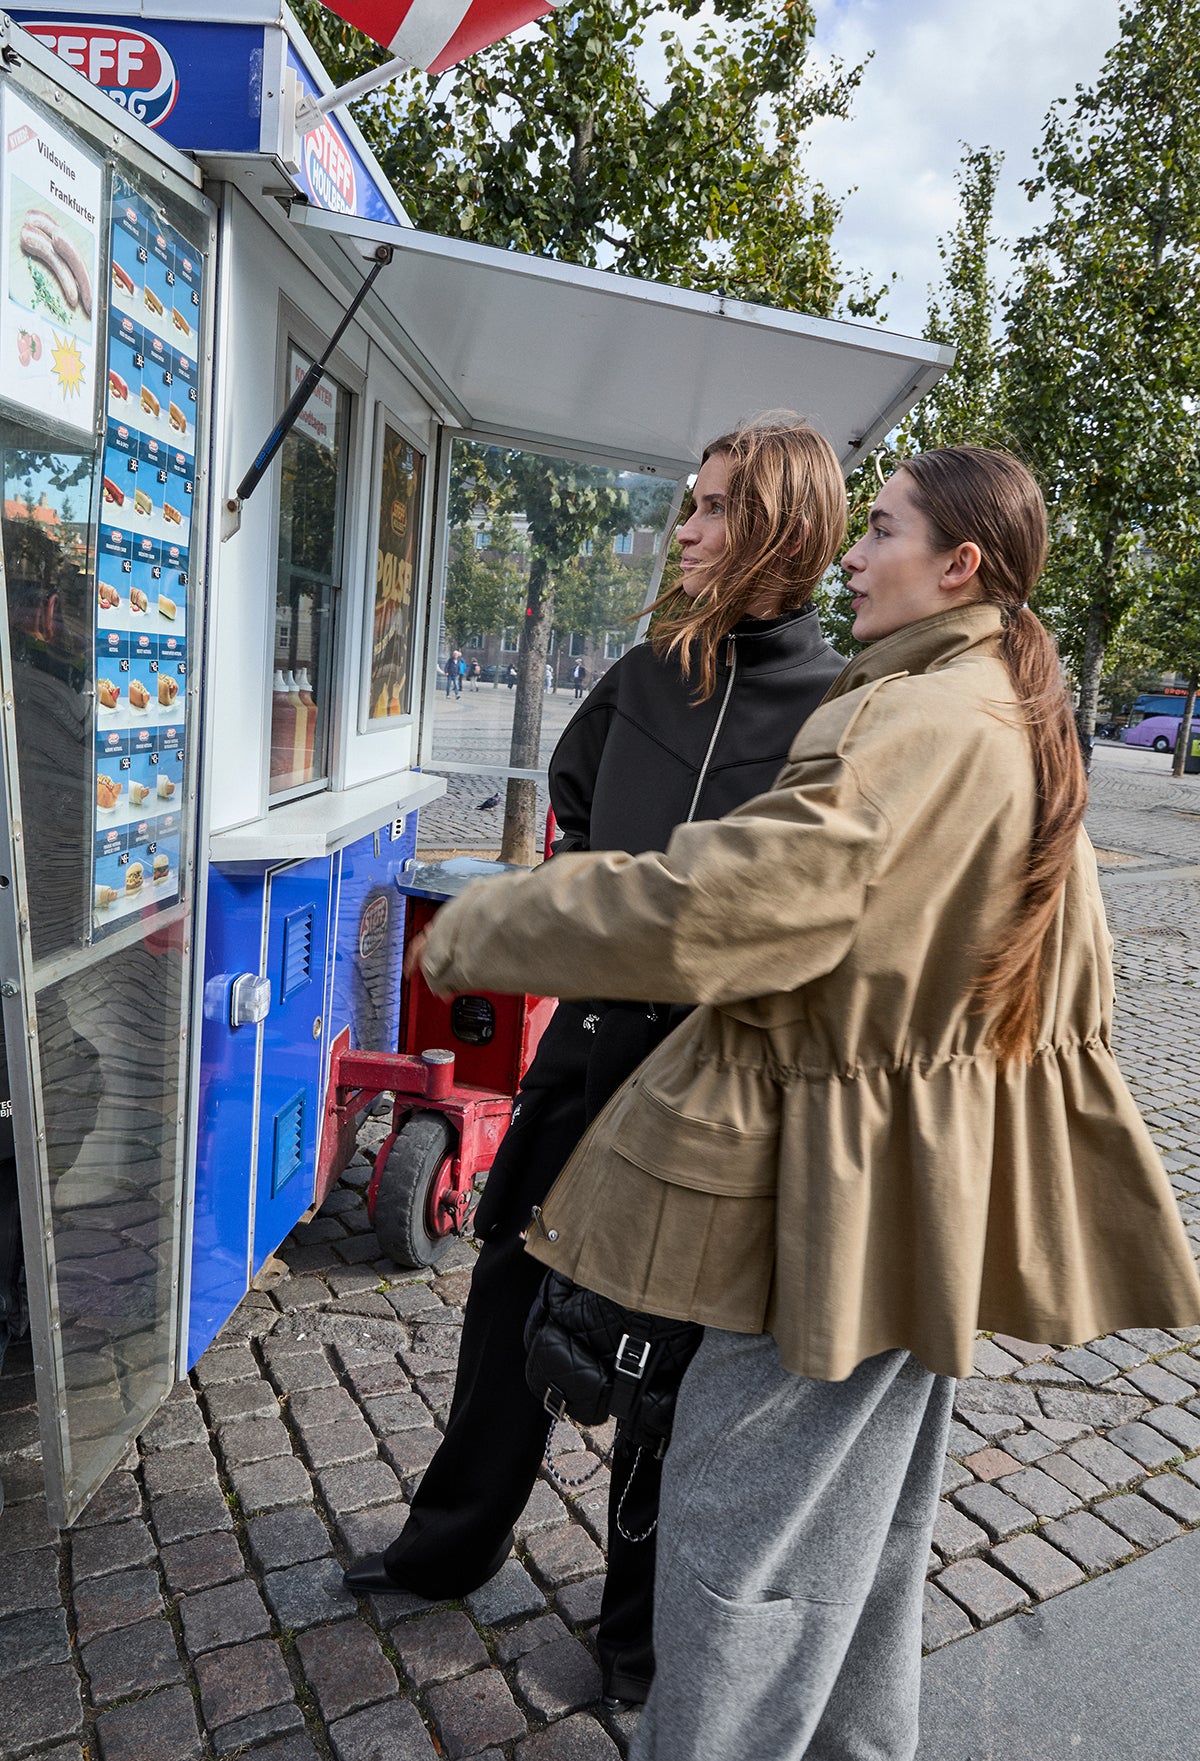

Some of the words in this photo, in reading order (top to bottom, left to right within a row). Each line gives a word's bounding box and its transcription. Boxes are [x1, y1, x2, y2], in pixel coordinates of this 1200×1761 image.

[33, 34, 146, 87] EFF
[37, 138, 76, 180] Vildsvine
[49, 180, 95, 224] Frankfurter
